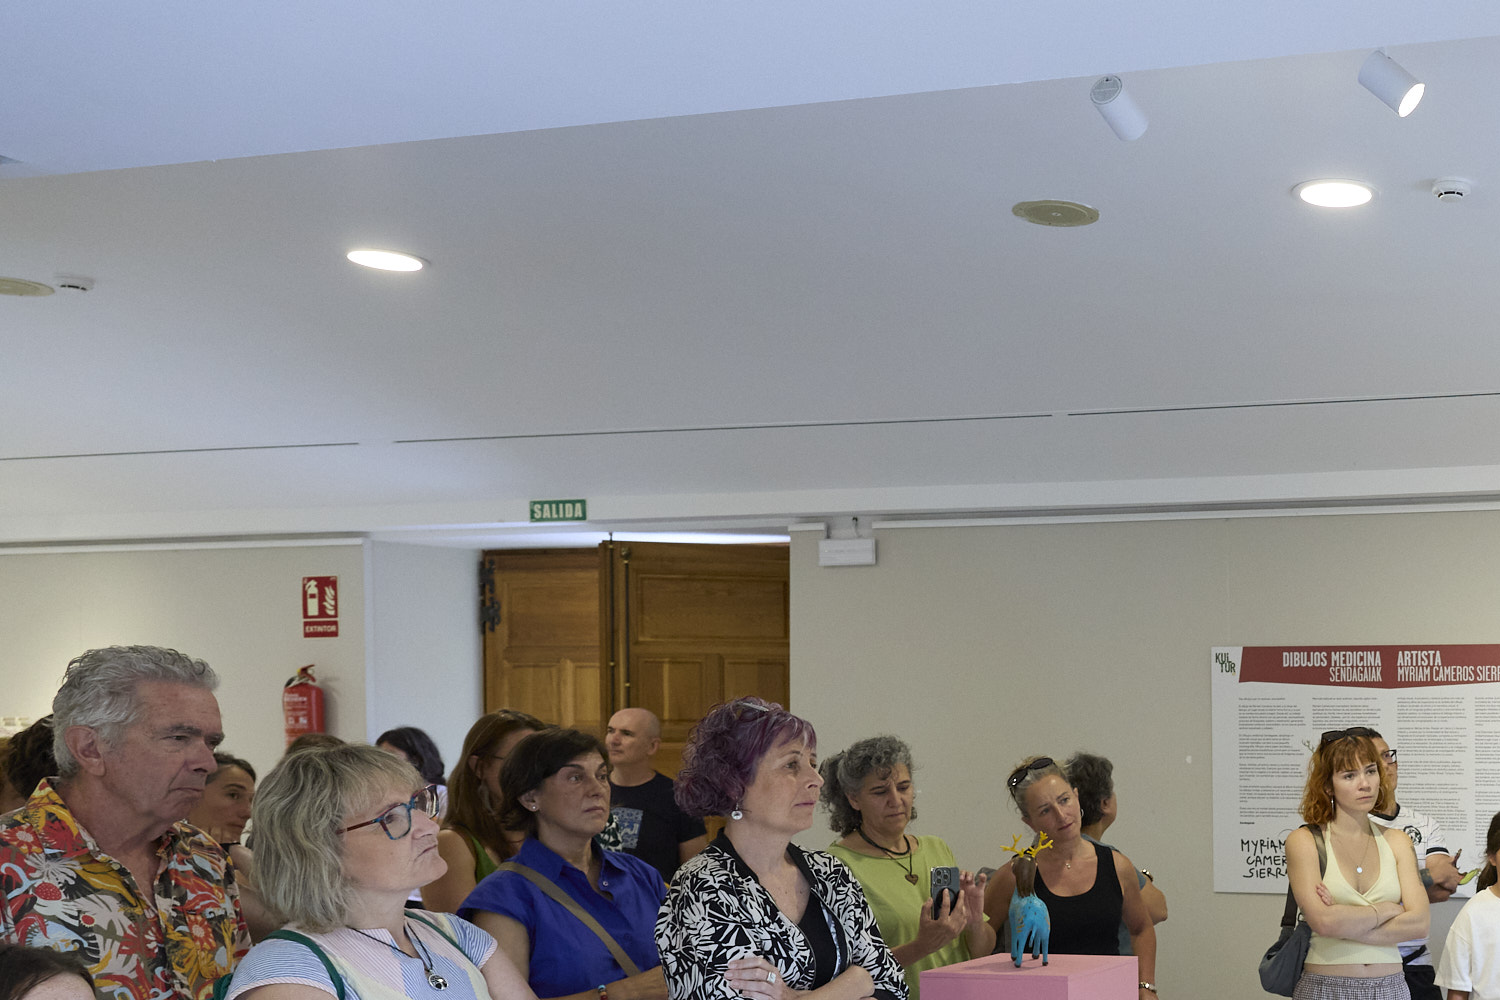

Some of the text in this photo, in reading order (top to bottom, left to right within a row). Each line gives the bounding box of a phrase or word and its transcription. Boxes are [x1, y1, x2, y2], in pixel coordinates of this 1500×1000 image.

[533, 502, 583, 519] SALIDA
[305, 625, 337, 633] EXTINTOR
[1282, 650, 1382, 667] DIBUJOS MEDICINA
[1396, 650, 1442, 667] ARTISTA
[1329, 666, 1382, 682] SENDAGAIAK
[1397, 665, 1431, 682] MYRIAM
[1433, 665, 1475, 682] CAMEROS
[1242, 867, 1288, 879] SIERR
